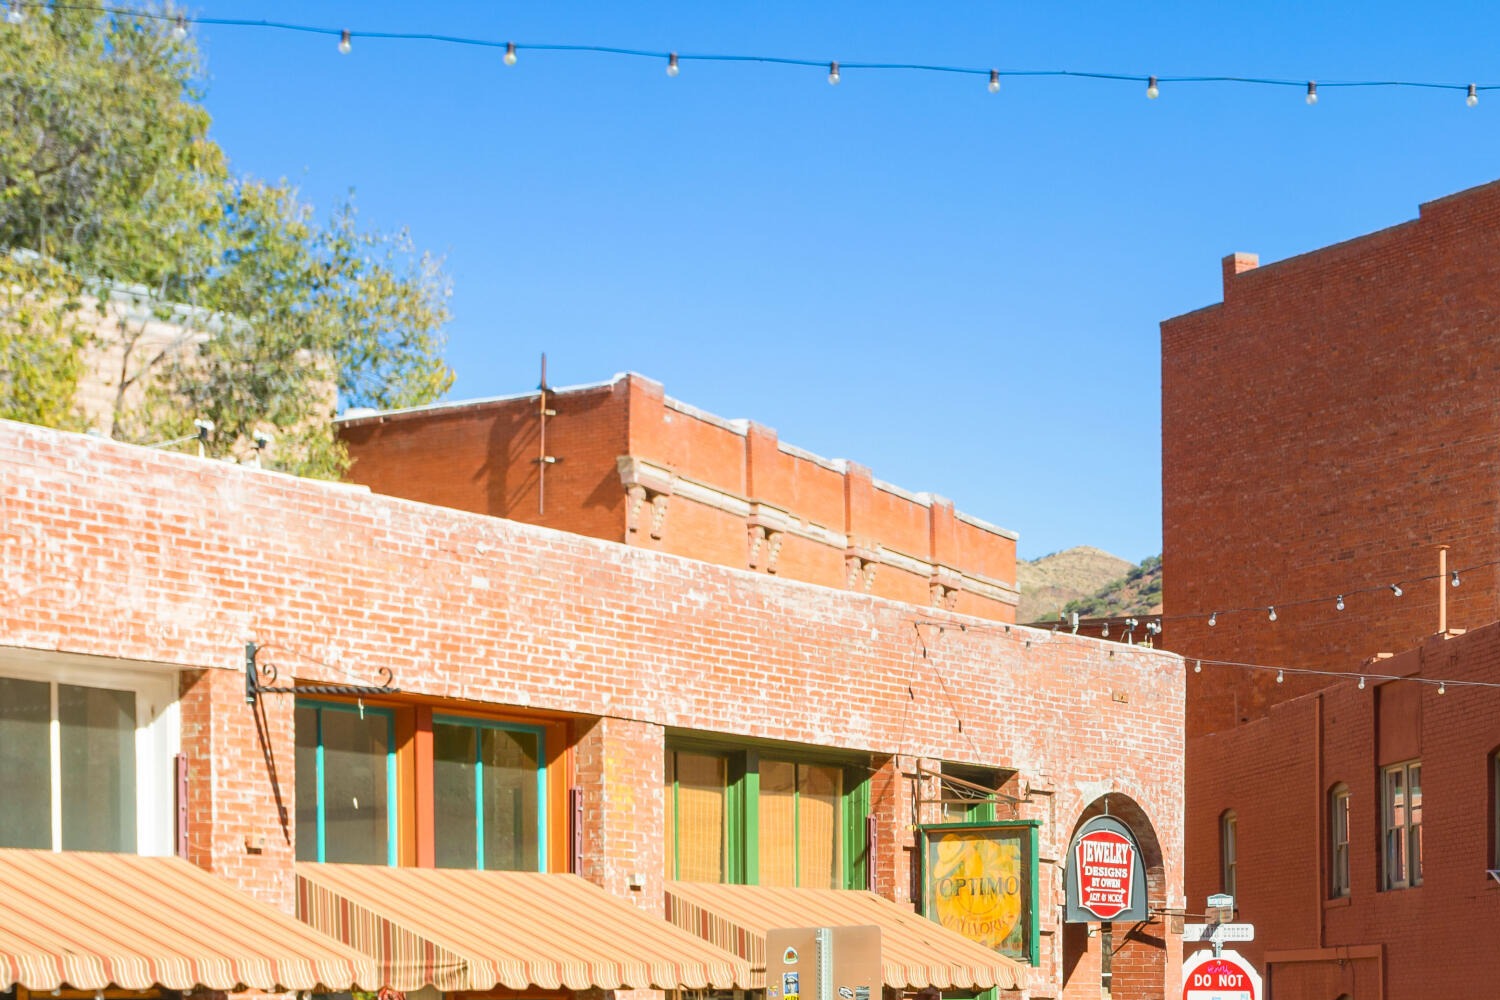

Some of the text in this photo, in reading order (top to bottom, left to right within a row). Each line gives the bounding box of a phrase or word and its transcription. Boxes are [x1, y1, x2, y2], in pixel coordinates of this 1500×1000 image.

[1082, 840, 1129, 868] JEWELRY
[1084, 865, 1128, 879] DESIGNS
[940, 876, 1020, 898] OPTIMO
[1091, 877, 1121, 888] BY OWEN
[1194, 973, 1244, 988] DO NOT
